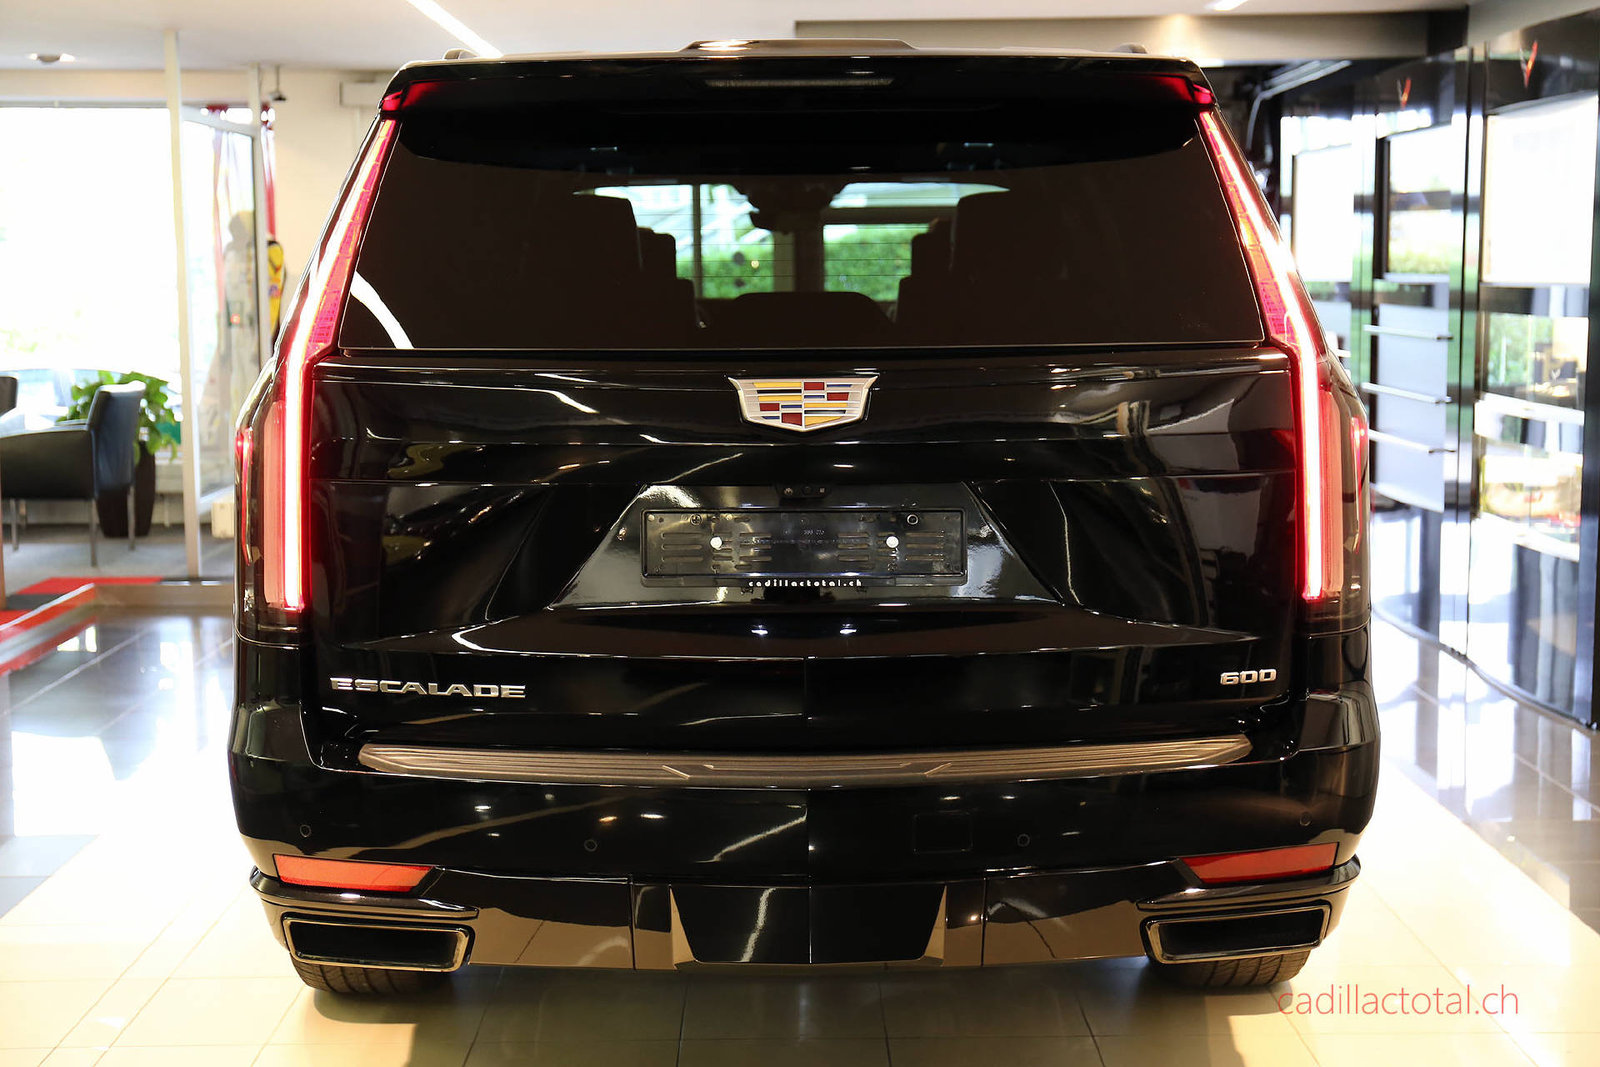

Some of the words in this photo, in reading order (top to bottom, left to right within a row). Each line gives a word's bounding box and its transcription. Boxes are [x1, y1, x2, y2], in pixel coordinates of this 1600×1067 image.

[748, 579, 862, 587] cadillactotal.ch
[1220, 668, 1277, 685] 600
[330, 677, 526, 698] ESCALADE
